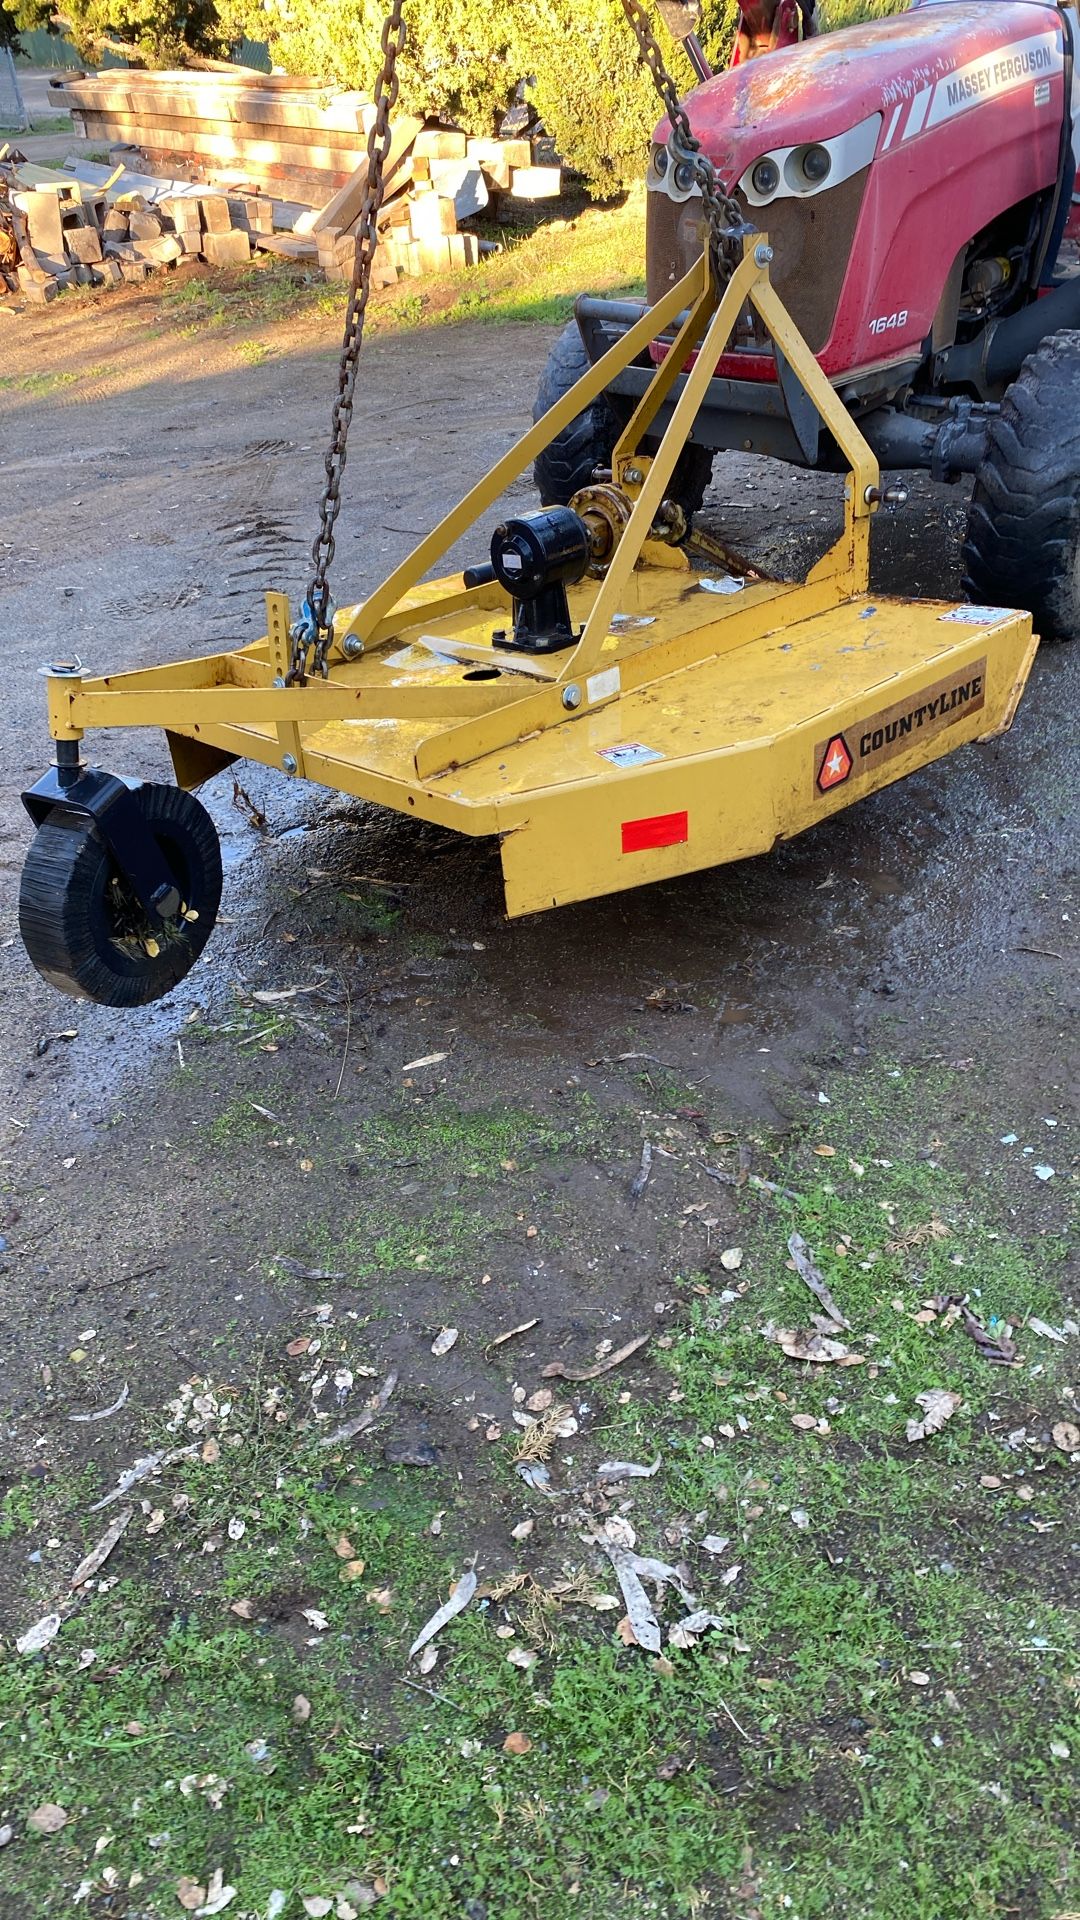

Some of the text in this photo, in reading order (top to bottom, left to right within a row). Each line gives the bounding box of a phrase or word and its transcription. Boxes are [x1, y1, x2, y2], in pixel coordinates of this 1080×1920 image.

[947, 68, 991, 106] MASSEY
[993, 46, 1051, 84] FERGUSON
[868, 310, 908, 335] 1648
[859, 675, 982, 758] COUNTYLINE
